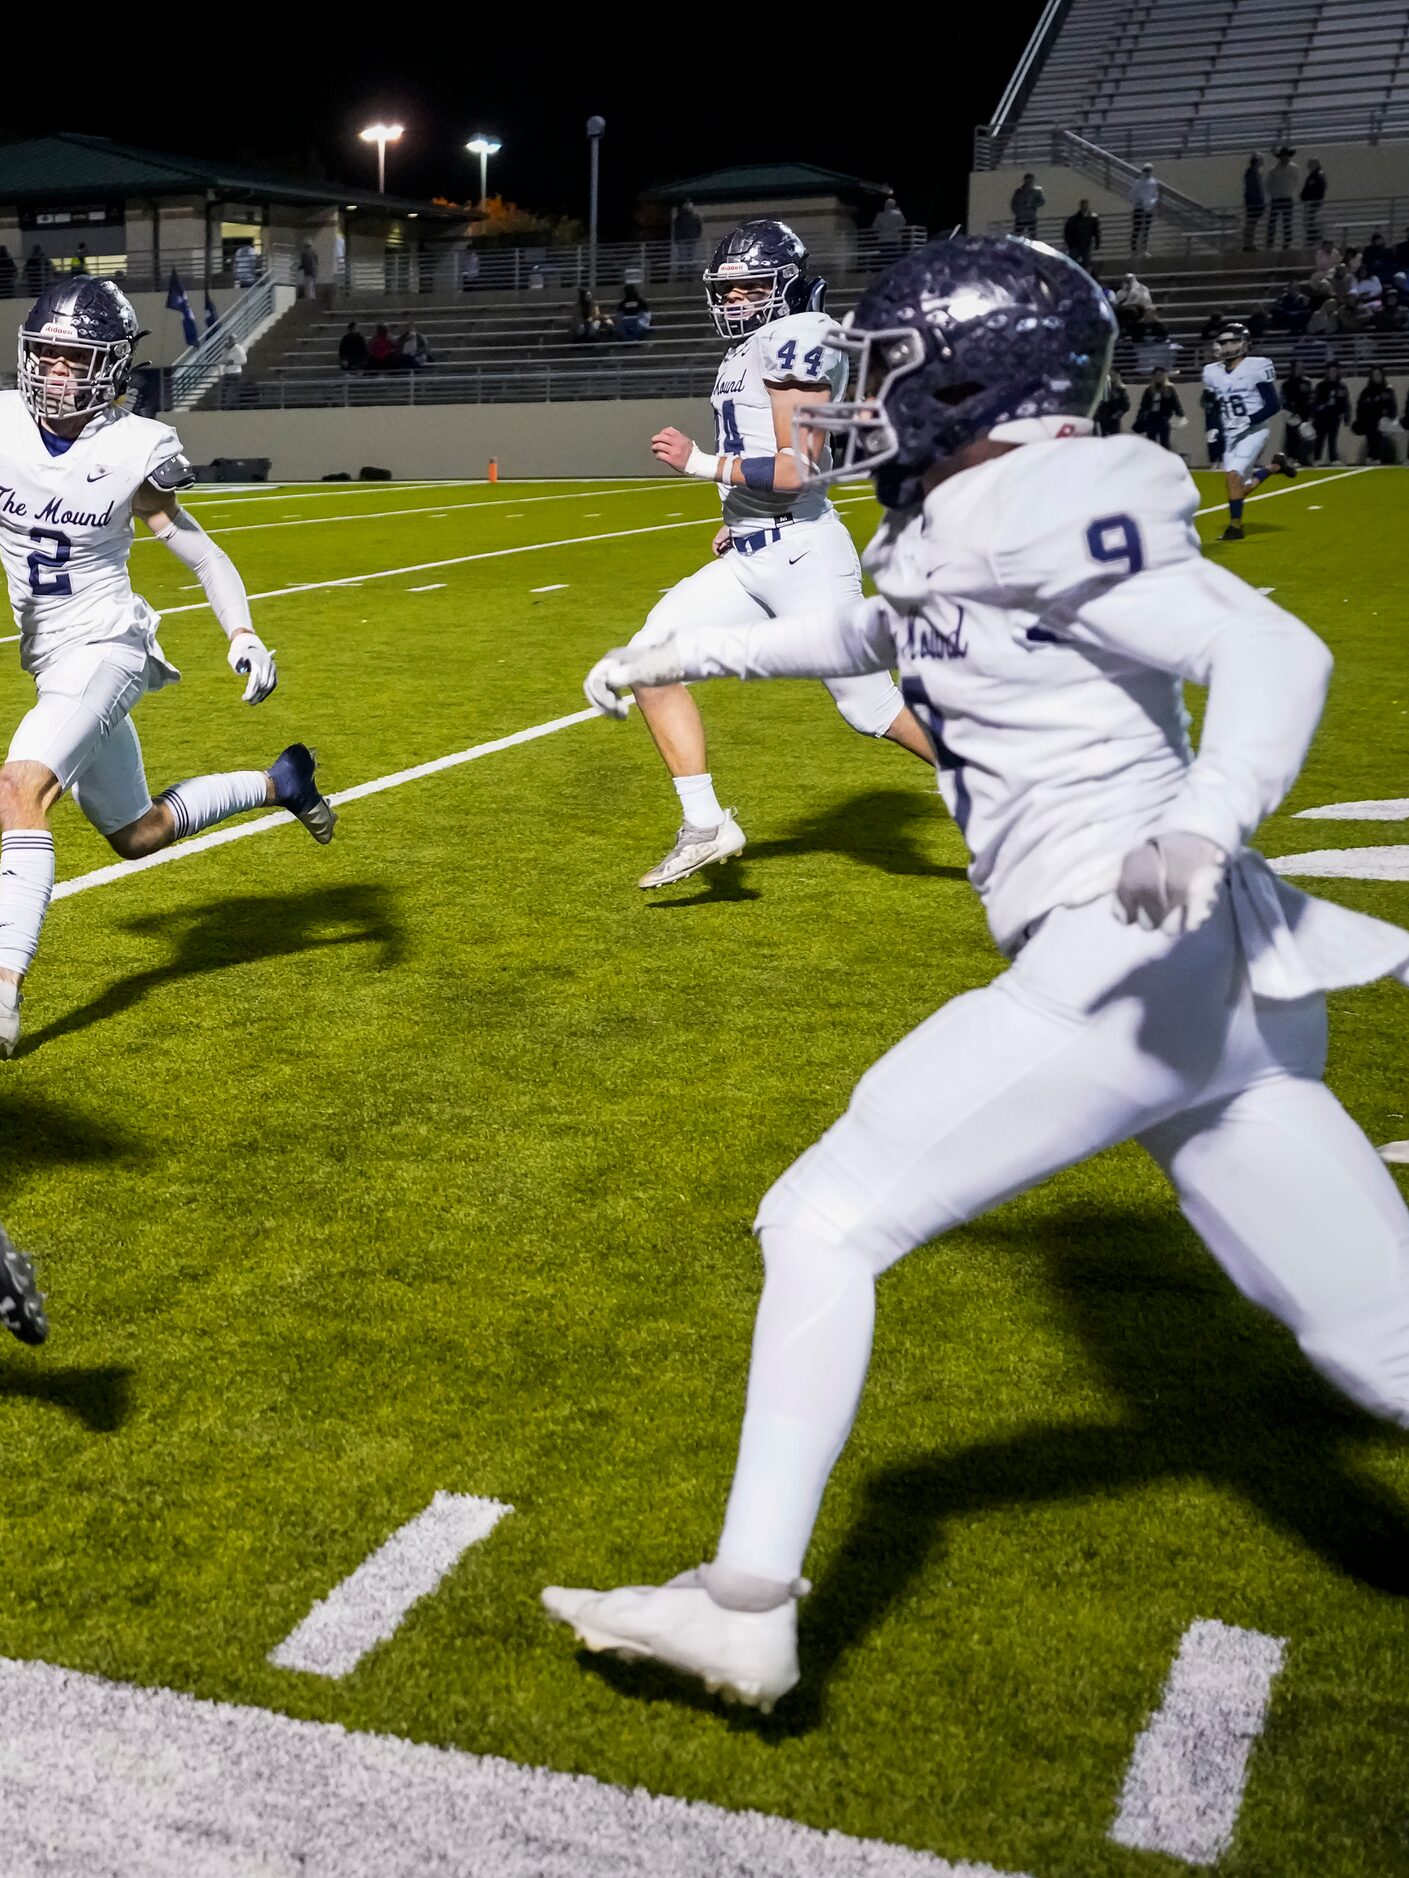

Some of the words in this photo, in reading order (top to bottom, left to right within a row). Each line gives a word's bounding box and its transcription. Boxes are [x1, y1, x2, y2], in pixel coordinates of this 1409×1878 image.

[777, 338, 824, 377] 44
[34, 495, 115, 528] Mound
[26, 526, 73, 597] 2
[1085, 511, 1145, 575] 9
